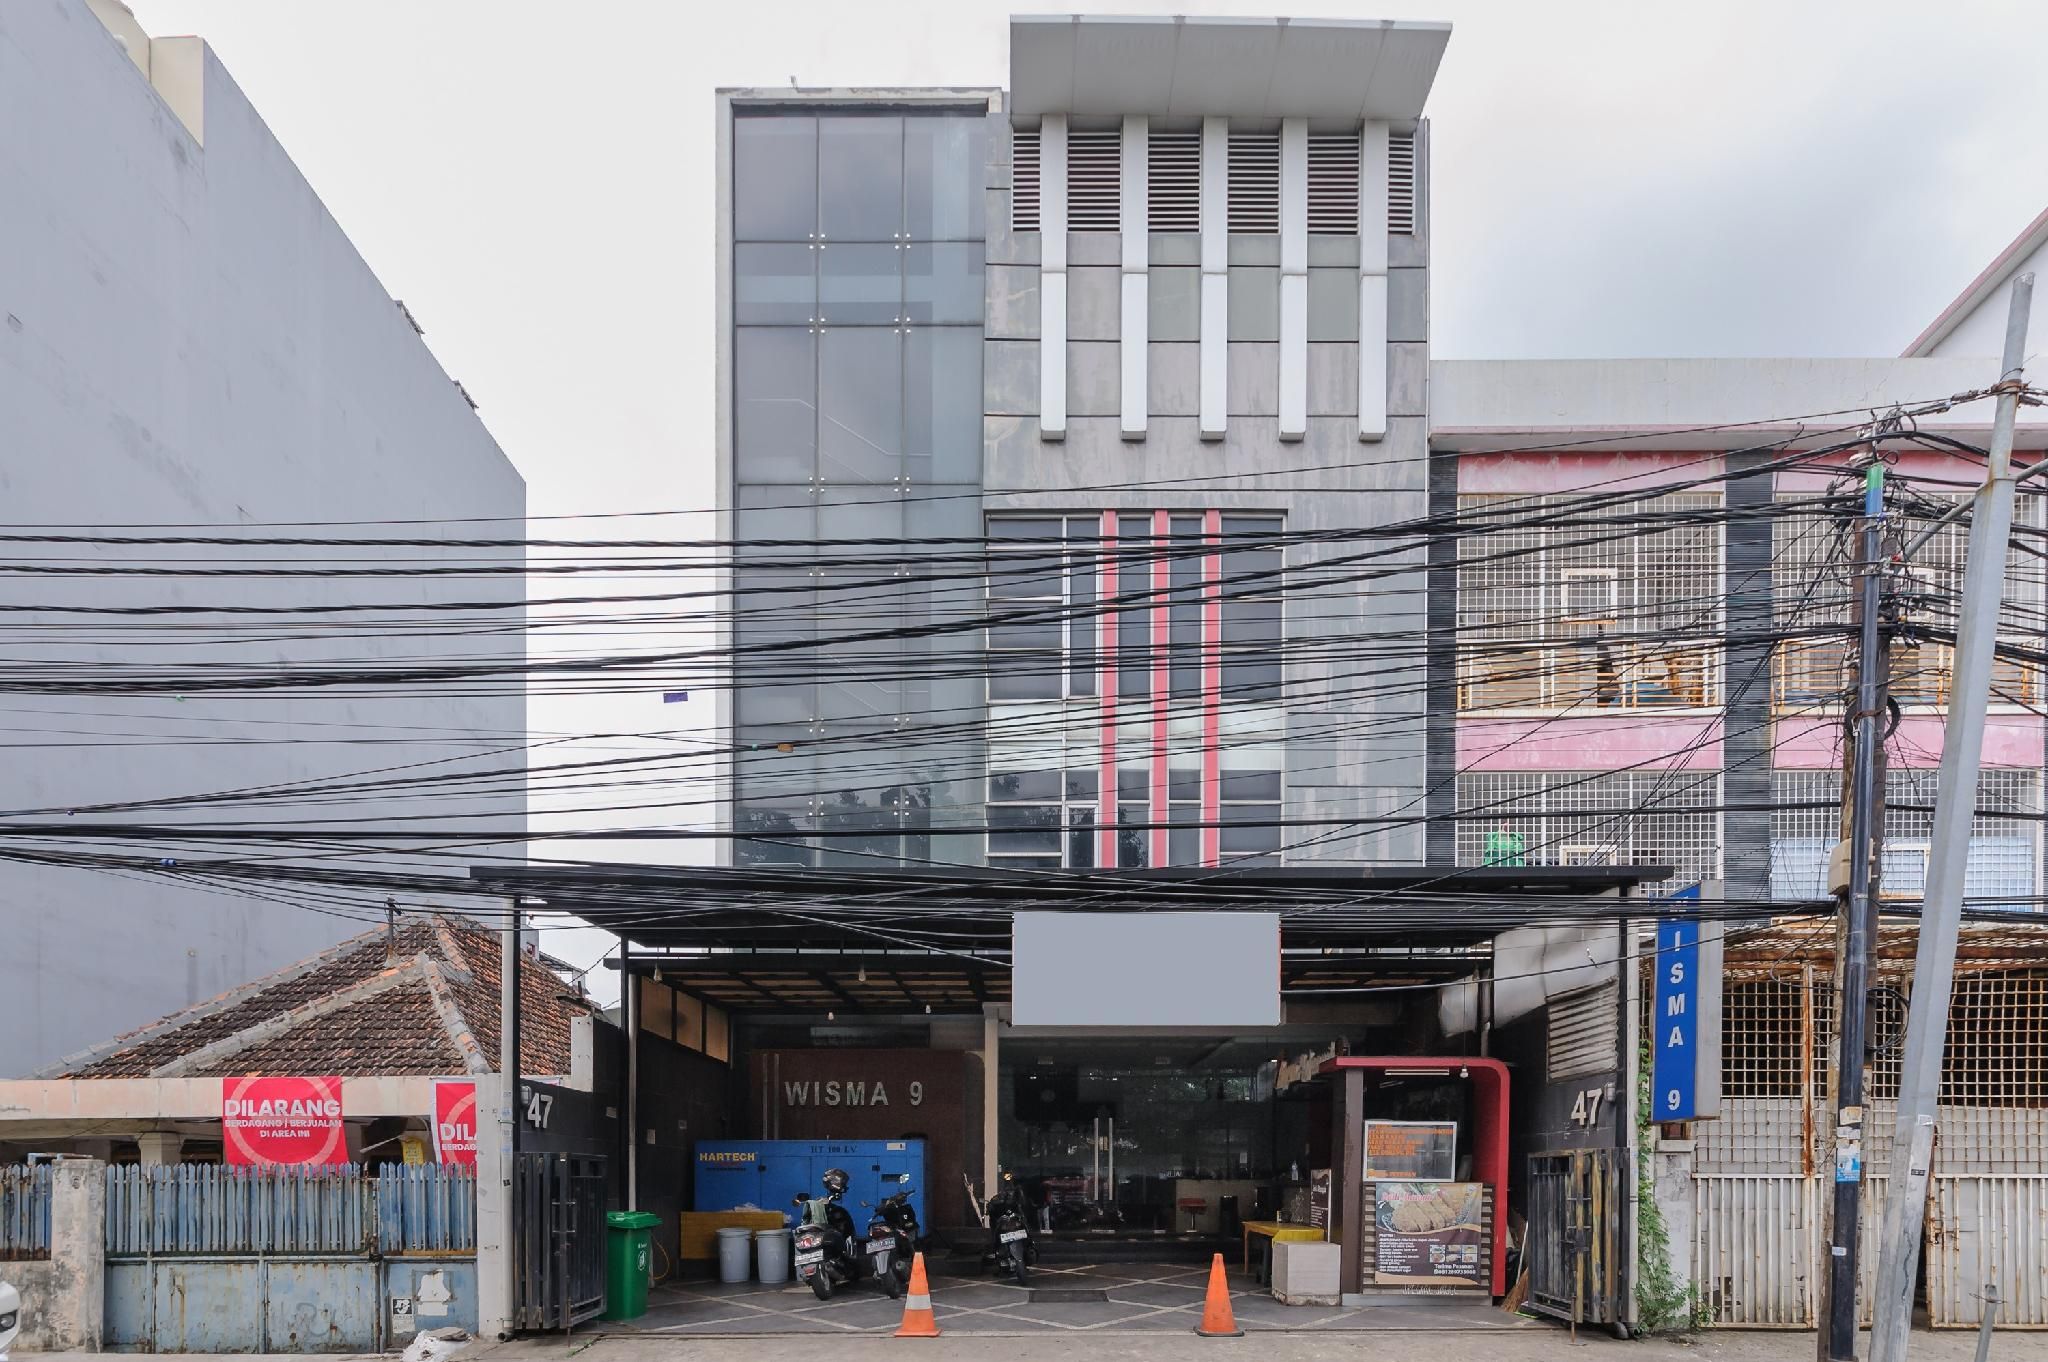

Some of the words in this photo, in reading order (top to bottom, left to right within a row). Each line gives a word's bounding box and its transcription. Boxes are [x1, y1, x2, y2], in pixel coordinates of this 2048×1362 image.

[784, 1081, 889, 1106] WISMA
[909, 1081, 923, 1106] 9
[1667, 1089, 1681, 1111] 9
[224, 1099, 340, 1117] DILARANG
[527, 1092, 553, 1129] 47
[1570, 1087, 1603, 1126] 47
[224, 1119, 283, 1128] BERDAGANG
[289, 1119, 342, 1128] BERJUALAN
[439, 1123, 478, 1141] DIL
[259, 1129, 270, 1138] DI
[271, 1129, 297, 1138] AREA
[297, 1129, 310, 1138] INI
[699, 1152, 755, 1161] HARTECH
